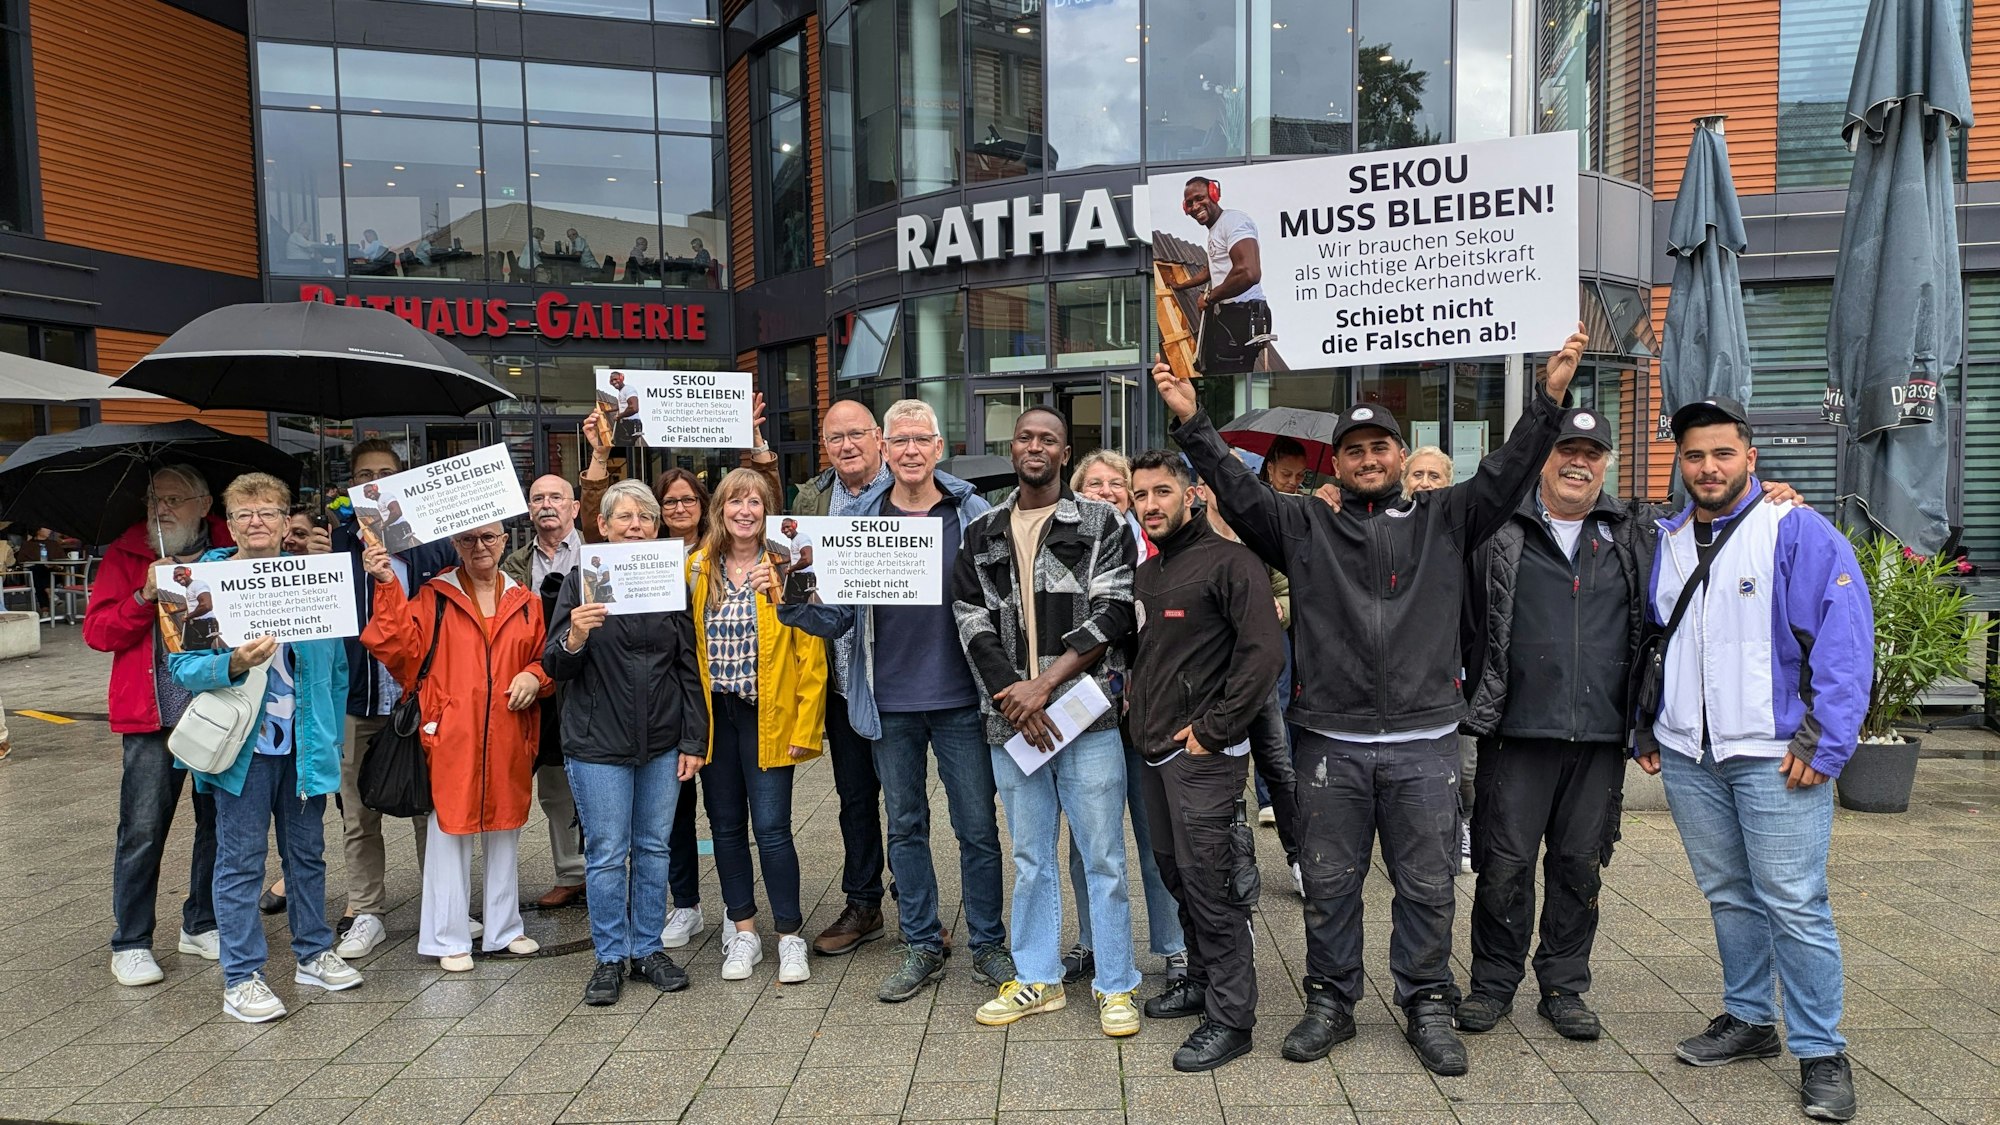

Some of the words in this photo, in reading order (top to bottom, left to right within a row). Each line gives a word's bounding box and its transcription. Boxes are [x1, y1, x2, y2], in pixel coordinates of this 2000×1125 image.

[1349, 154, 1468, 193] SEKOU
[1280, 203, 1376, 238] MUSS
[1388, 184, 1554, 227] BLEIBEN!
[1318, 243, 1351, 259] Wir
[1359, 232, 1448, 255] brauchen
[1455, 228, 1514, 246] Sekou
[1295, 265, 1320, 281] als
[1328, 259, 1407, 279] wichtige
[1414, 245, 1535, 271] Arbeitskraft
[1295, 286, 1318, 301] im
[1325, 265, 1541, 299] Dachdeckerhandwerk.
[300, 284, 706, 340] THAUS-GALERIE
[1336, 303, 1424, 328] Schiebt
[1433, 298, 1494, 320] nicht
[1322, 334, 1358, 354] die
[1366, 328, 1471, 352] Falschen
[1479, 321, 1517, 342] ab!
[673, 375, 715, 385] SEKOU
[647, 388, 682, 398] MUSS
[687, 389, 745, 400] BLEIBEN!
[426, 456, 471, 477] SEKOU
[404, 479, 441, 498] MUSS
[444, 460, 506, 486] BLEIBEN!
[422, 494, 435, 502] Wir
[437, 484, 471, 498] brauchen
[472, 476, 494, 487] Sekou
[428, 496, 459, 508] wichtige
[460, 481, 504, 498] Arbeitskraft
[428, 487, 509, 516] Dachdeckerhandwerk.
[434, 524, 448, 535] die
[450, 513, 490, 530] Falschen
[492, 507, 506, 517] ab!
[436, 508, 470, 524] Schiebt
[472, 501, 495, 513] nicht
[851, 521, 900, 532] SEKOU
[822, 536, 861, 547] MUSS
[867, 536, 933, 548] BLEIBEN!
[252, 559, 306, 574] SEKOU
[640, 561, 678, 569] BLEIBEN!
[221, 577, 266, 592] MUSS
[272, 572, 344, 588] BLEIBEN!
[844, 579, 880, 588] Schiebt
[884, 580, 909, 588] nicht
[245, 600, 282, 609] wichtige
[285, 594, 337, 605] Arbeitskraft
[259, 589, 299, 599] brauchen
[302, 587, 328, 595] Sekou
[838, 590, 852, 599] die
[856, 590, 899, 599] Falschen
[903, 590, 917, 599] ab!
[244, 603, 341, 617] Dachdeckerhandwerk.
[244, 631, 260, 640] die
[265, 626, 313, 637] Falschen
[316, 624, 332, 634] ab!
[250, 618, 291, 629] Schiebt
[295, 615, 321, 624] nicht
